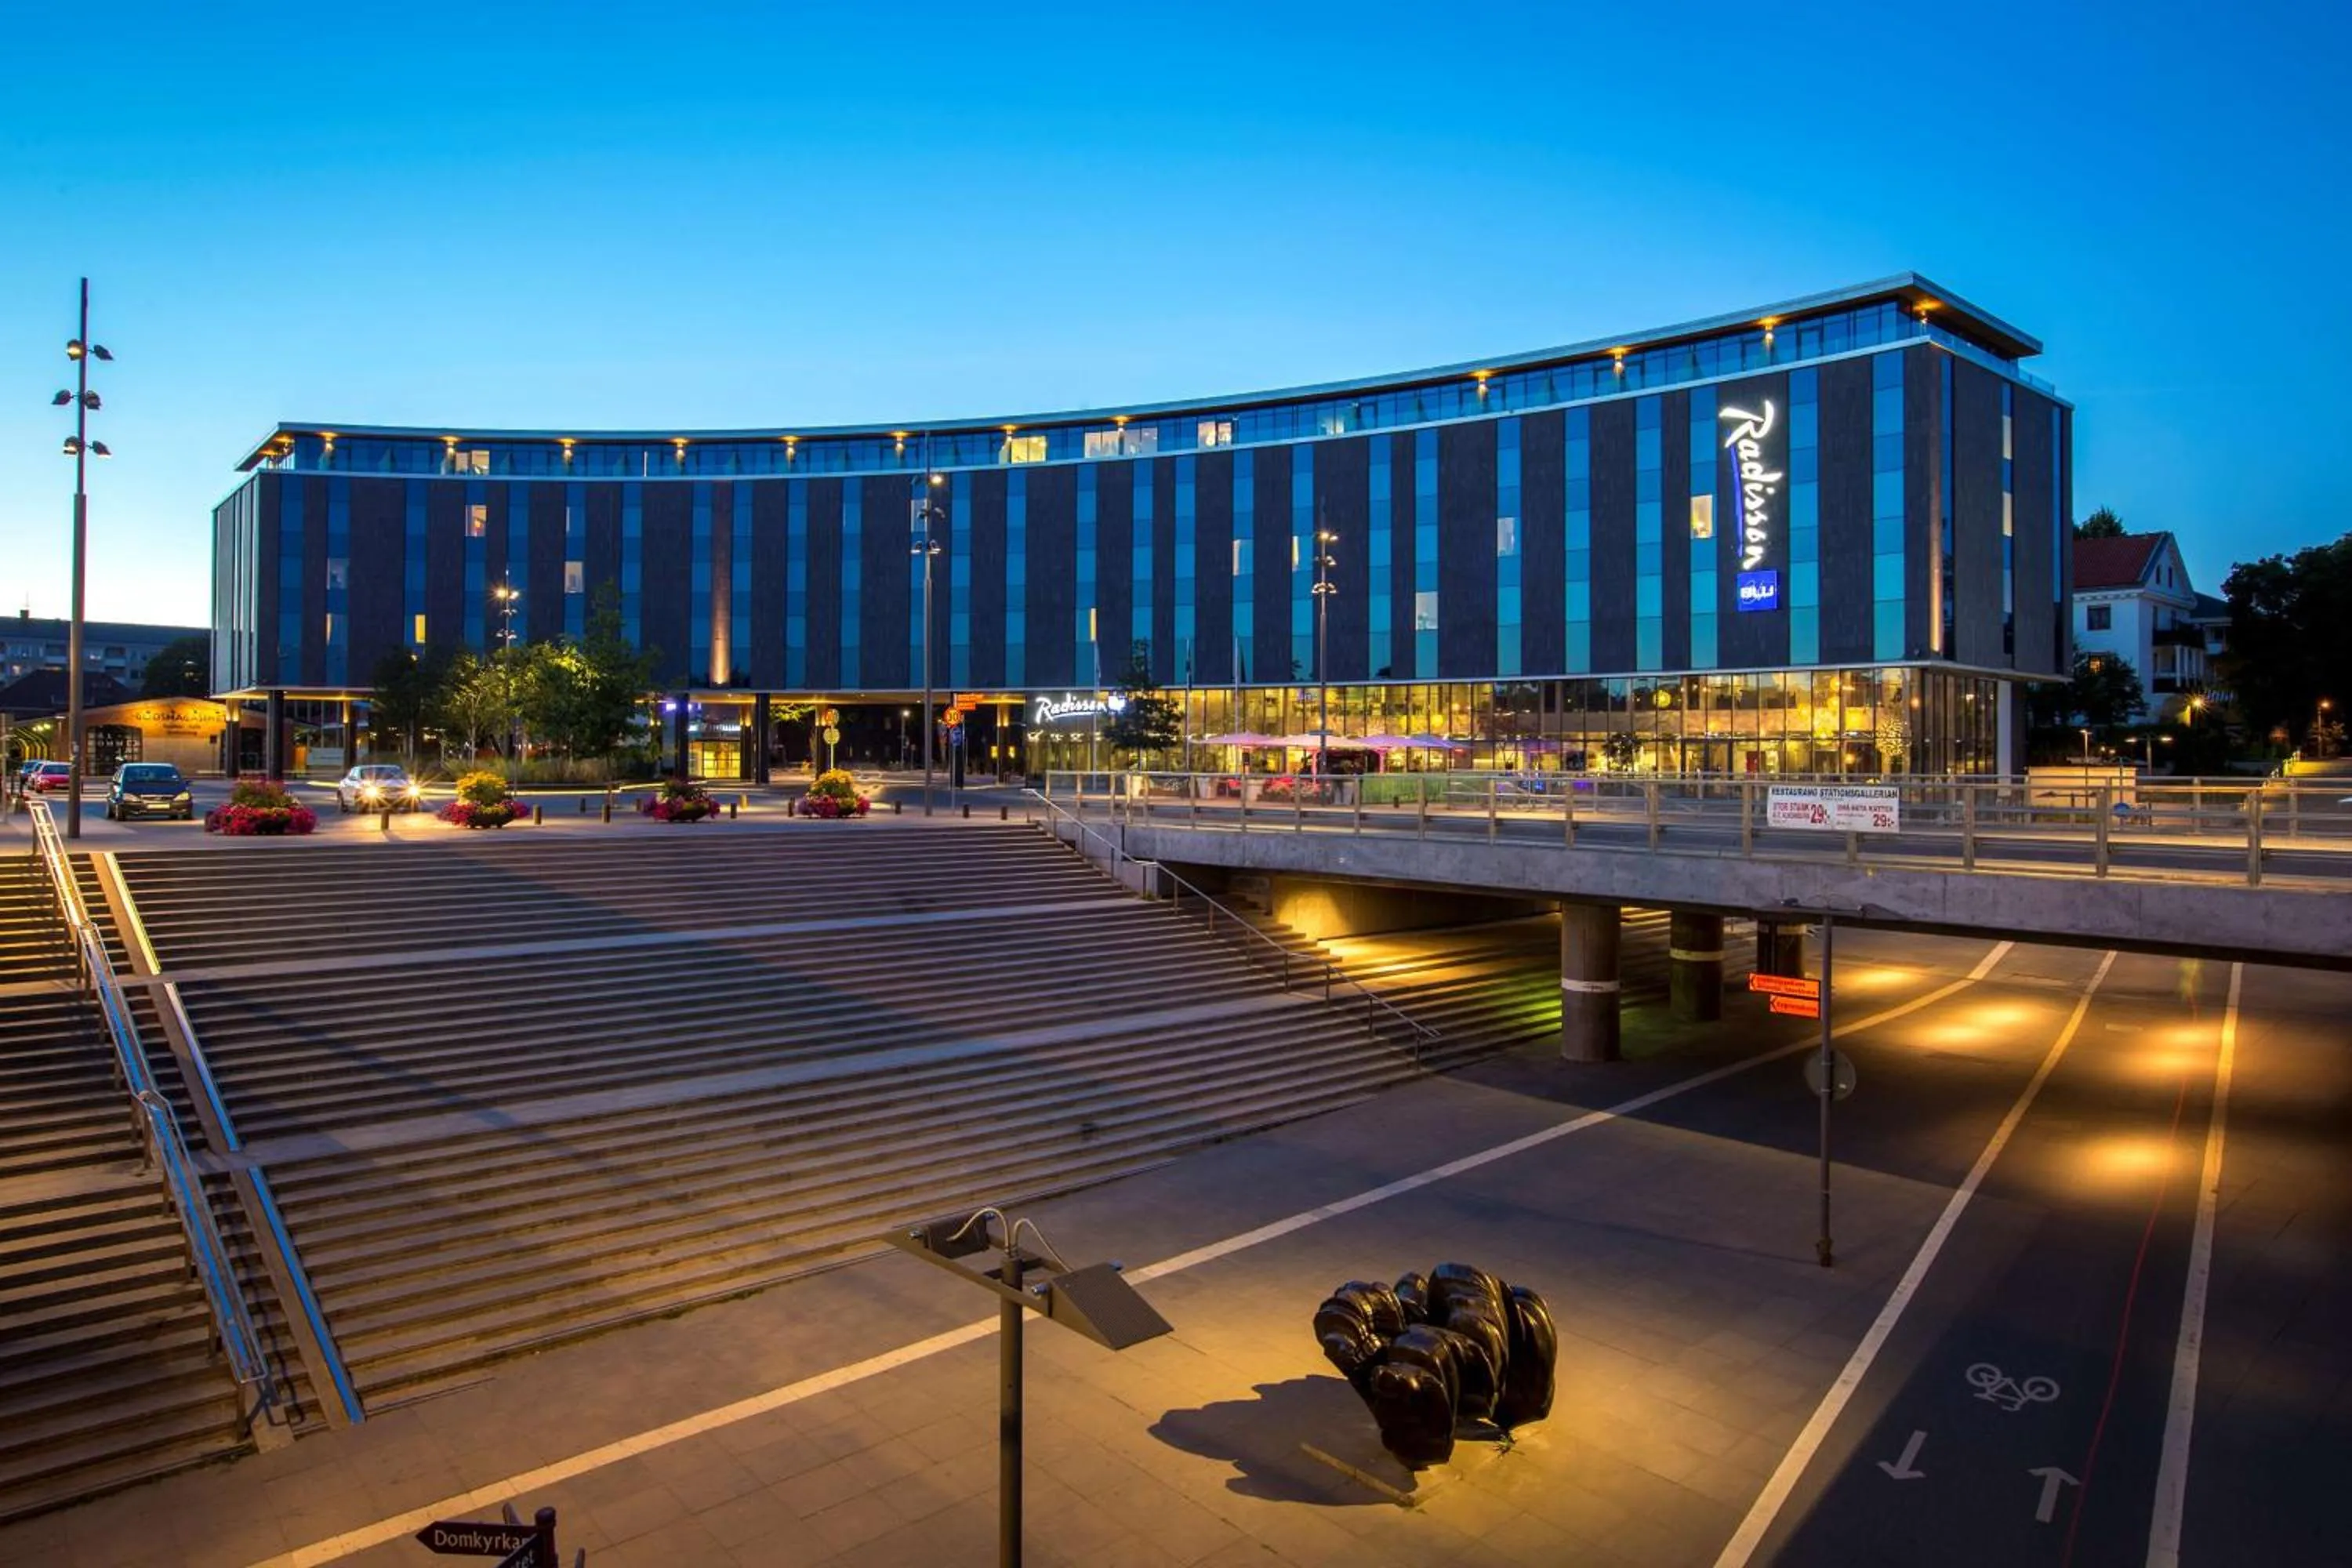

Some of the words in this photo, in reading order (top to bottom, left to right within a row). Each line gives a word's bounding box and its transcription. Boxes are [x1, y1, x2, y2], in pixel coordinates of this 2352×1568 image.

[1719, 400, 1783, 570] Radisson
[1035, 691, 1107, 724] Radisson
[1873, 813, 1894, 827] 29:-
